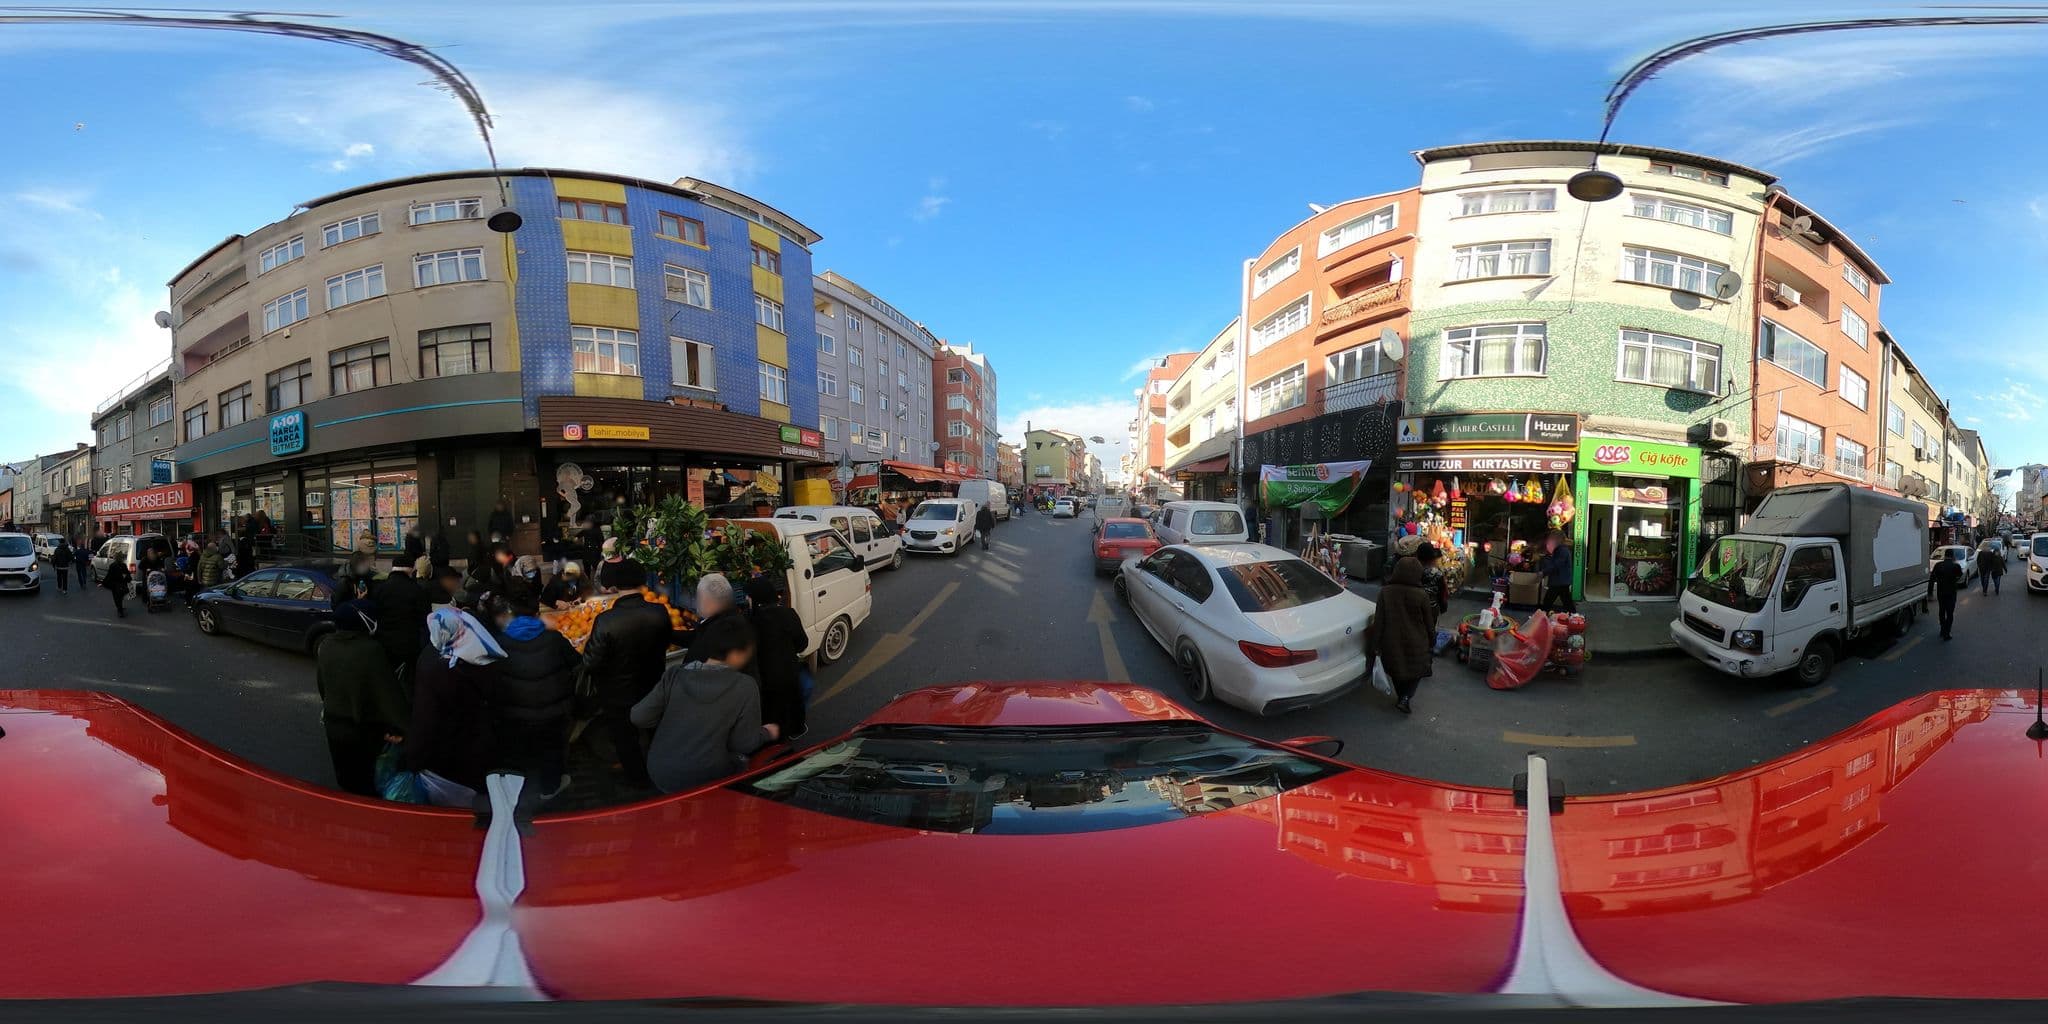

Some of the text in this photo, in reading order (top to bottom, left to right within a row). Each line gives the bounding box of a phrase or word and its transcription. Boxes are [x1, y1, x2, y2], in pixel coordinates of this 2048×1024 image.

[272, 424, 300, 436] HARCA
[1534, 420, 1570, 432] Huzur
[272, 432, 300, 444] HARCA
[1595, 445, 1688, 467] oses Çiğ köfte
[1422, 457, 1541, 470] HUZUR KIRTASİYE
[102, 490, 184, 512] GÜRAL PORSELEN
